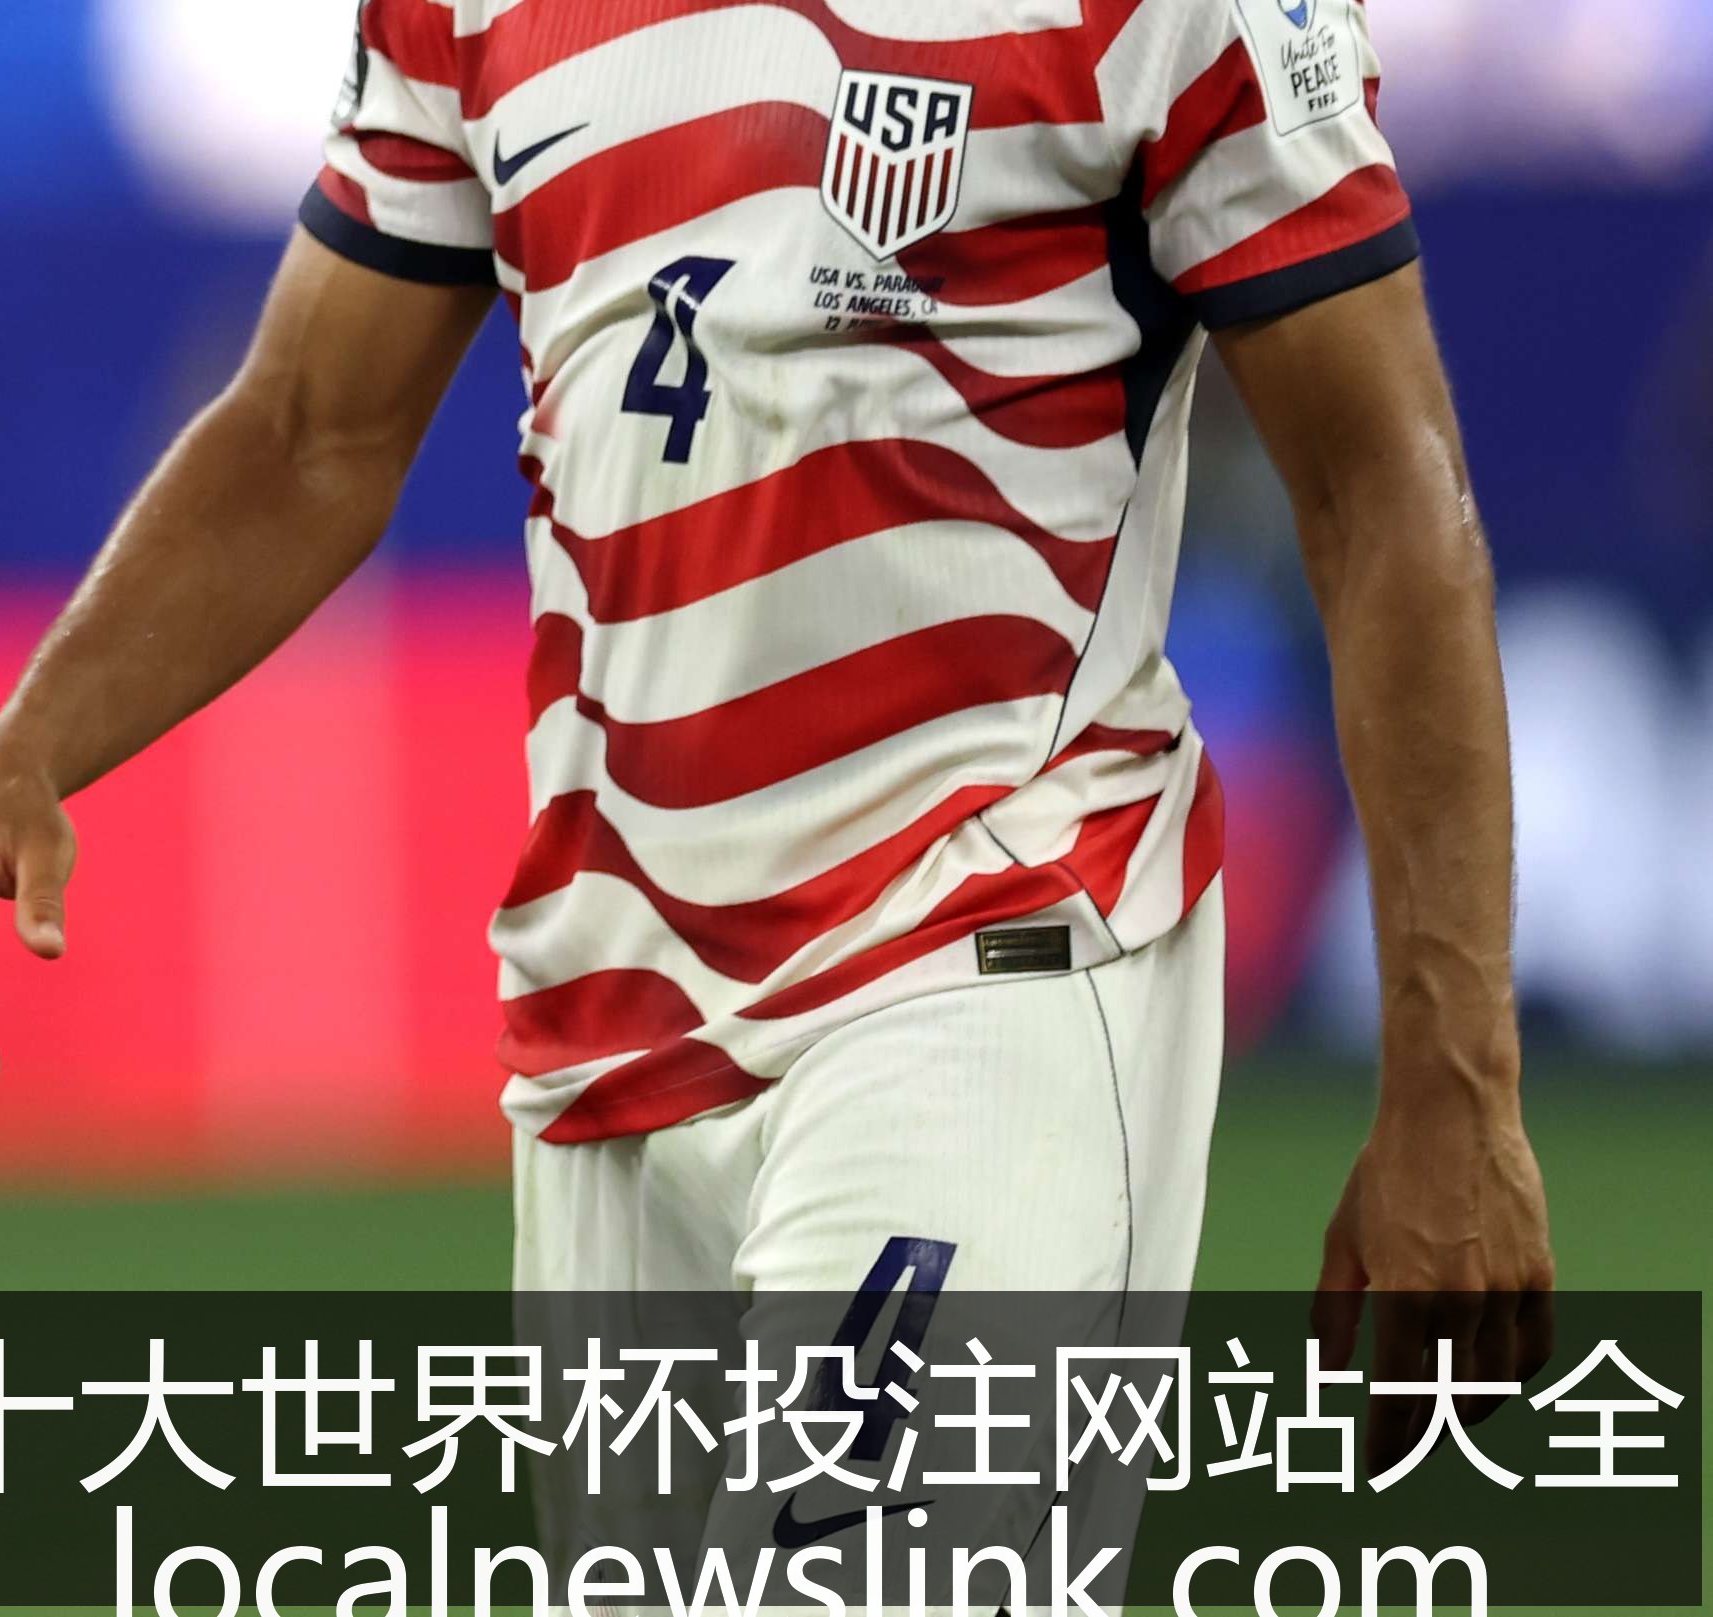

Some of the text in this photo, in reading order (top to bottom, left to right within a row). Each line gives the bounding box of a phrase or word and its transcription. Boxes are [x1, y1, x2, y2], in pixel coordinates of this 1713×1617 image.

[1290, 55, 1341, 98] PEACE
[844, 82, 961, 153] USA
[809, 265, 840, 286] USA
[845, 271, 867, 291] VS.
[814, 290, 842, 310] LOS
[620, 256, 736, 465] 4
[803, 1236, 958, 1462] 4
